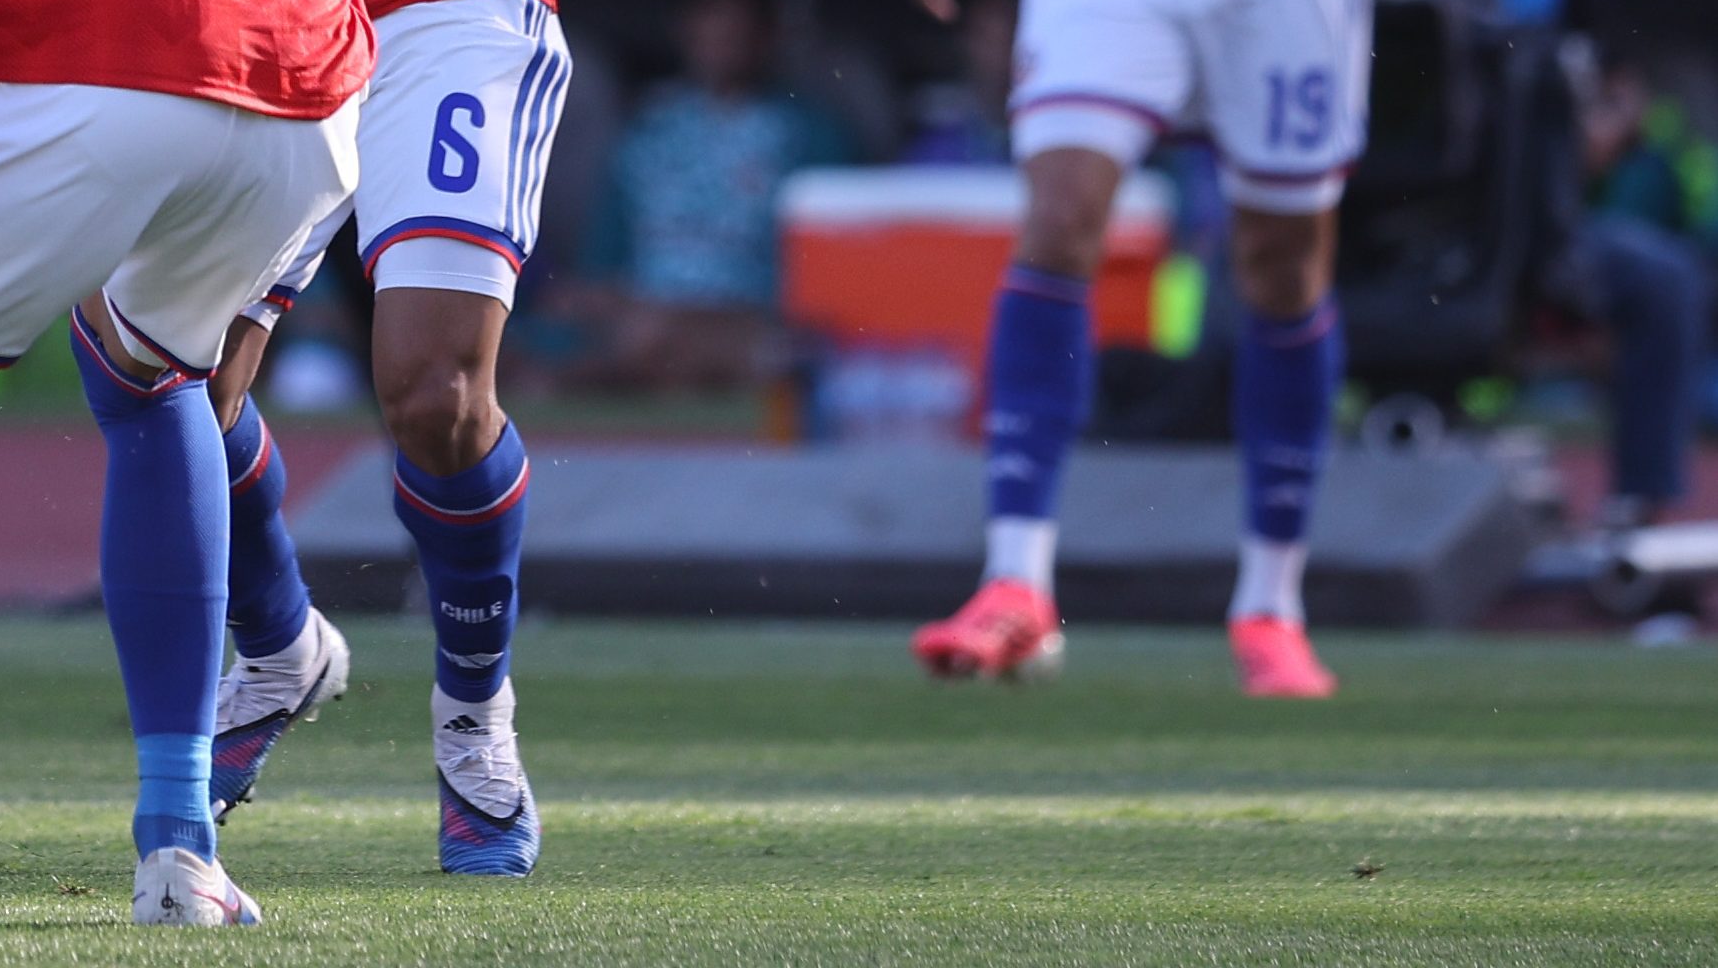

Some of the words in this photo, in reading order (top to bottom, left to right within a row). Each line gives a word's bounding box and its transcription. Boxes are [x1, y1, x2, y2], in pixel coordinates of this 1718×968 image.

[427, 92, 486, 193] 6
[1262, 68, 1336, 150] 19
[440, 600, 503, 624] CHILE
